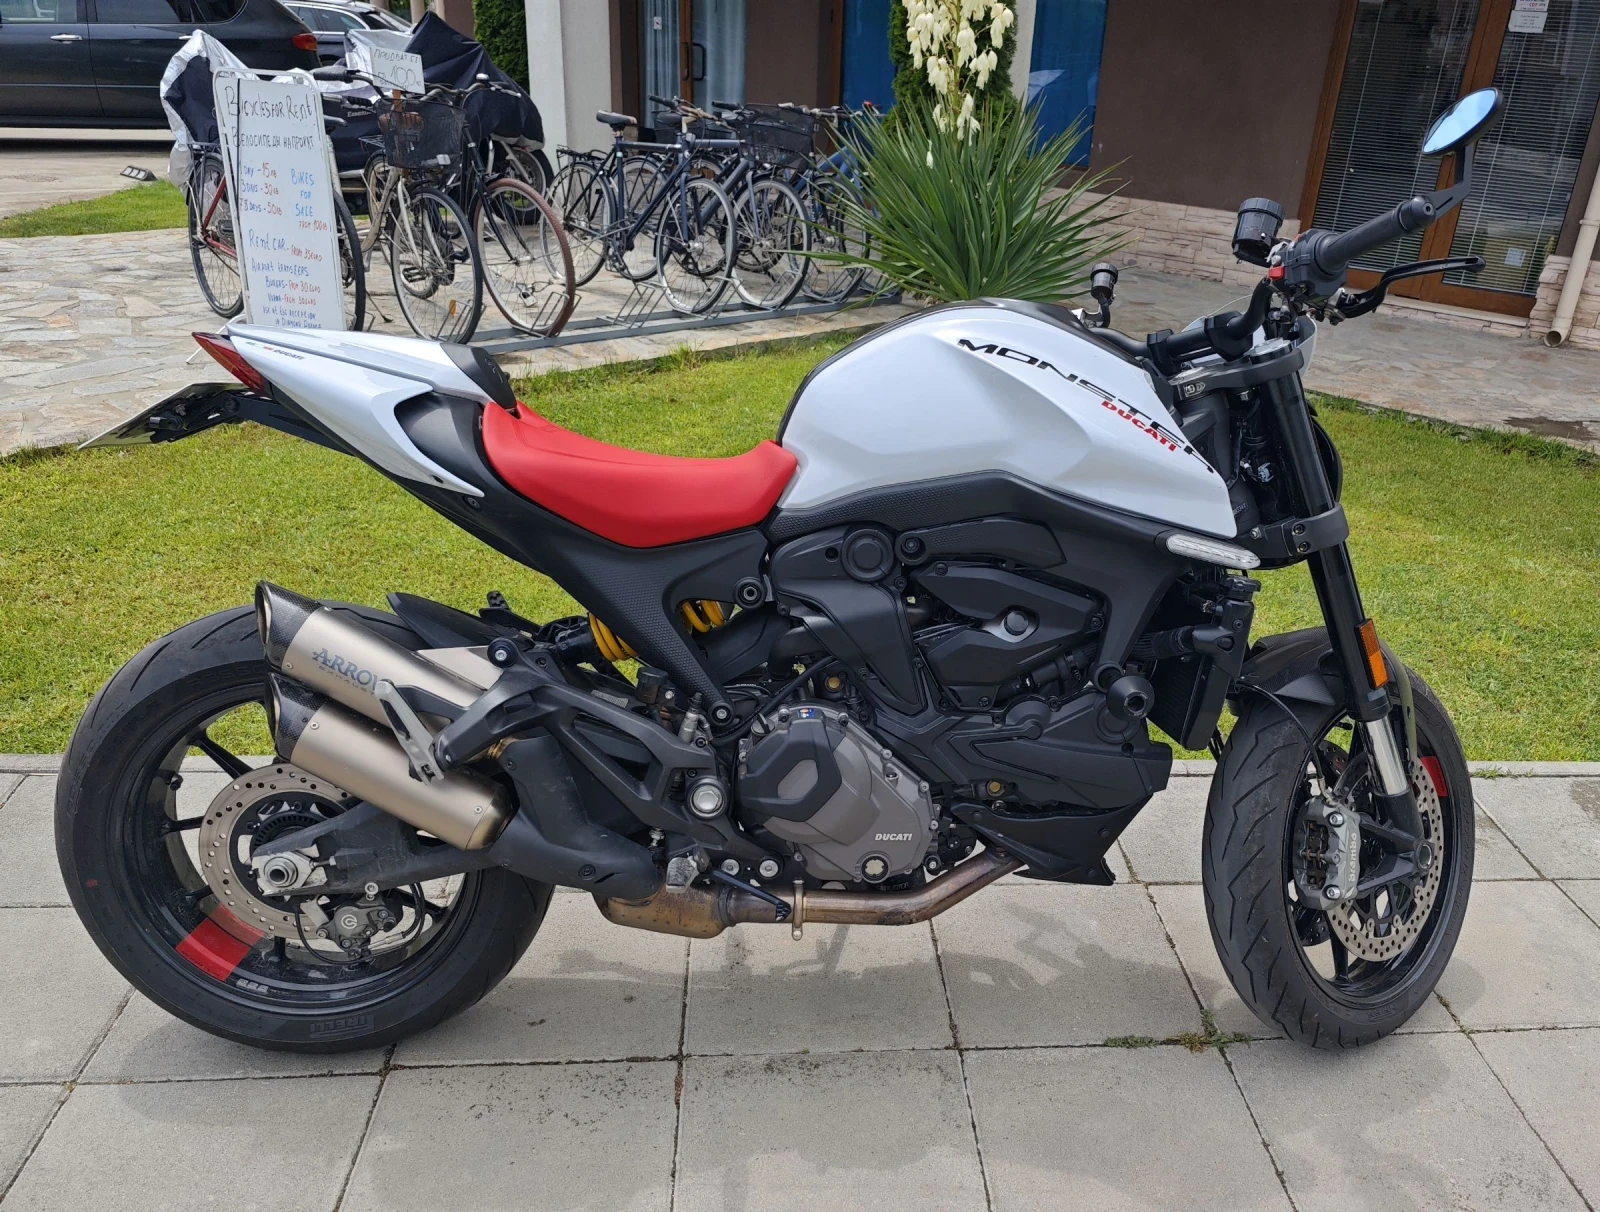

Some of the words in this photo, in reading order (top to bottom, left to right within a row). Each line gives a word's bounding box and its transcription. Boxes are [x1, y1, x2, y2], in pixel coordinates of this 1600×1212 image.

[300, 190, 312, 199] FOR
[295, 203, 314, 217] SALE
[1101, 400, 1177, 452] DUCATI
[874, 833, 913, 841] DUCATI
[1348, 832, 1358, 883] brembo
